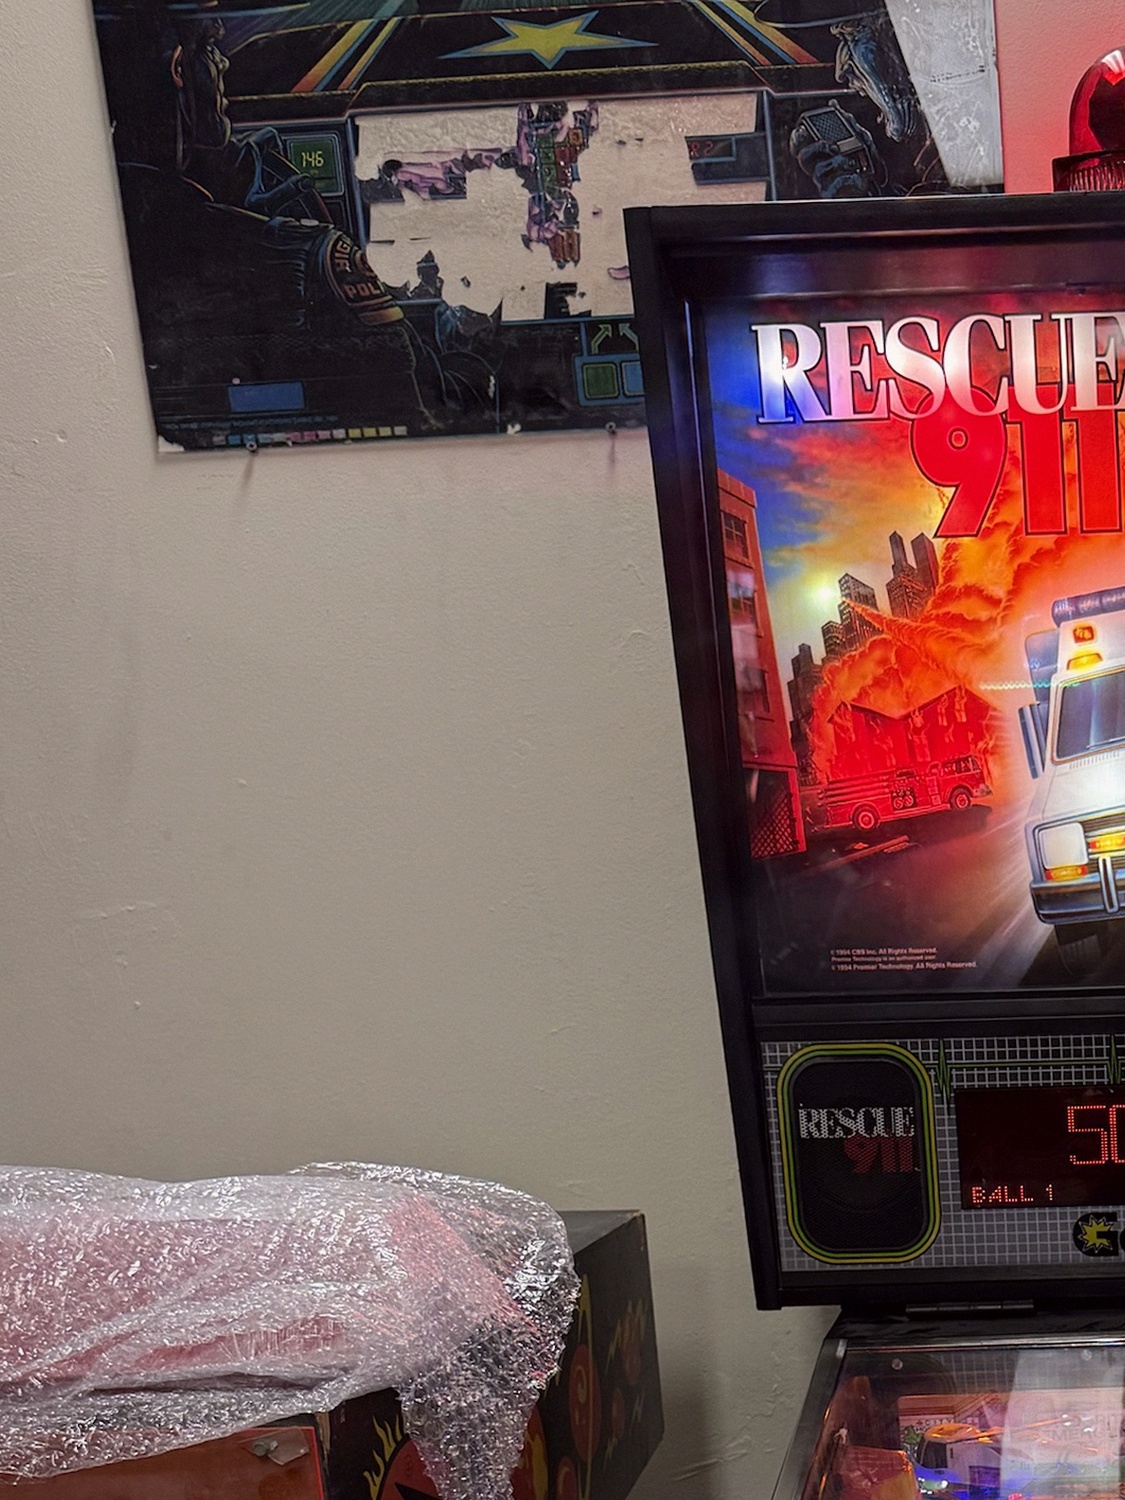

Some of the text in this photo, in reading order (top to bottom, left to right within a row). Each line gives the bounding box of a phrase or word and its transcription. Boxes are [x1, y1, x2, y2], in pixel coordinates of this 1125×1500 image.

[301, 151, 324, 167] 146
[910, 383, 1123, 538] 911
[798, 1107, 915, 1138] RESCUE
[972, 1184, 1053, 1203] BALL 1
